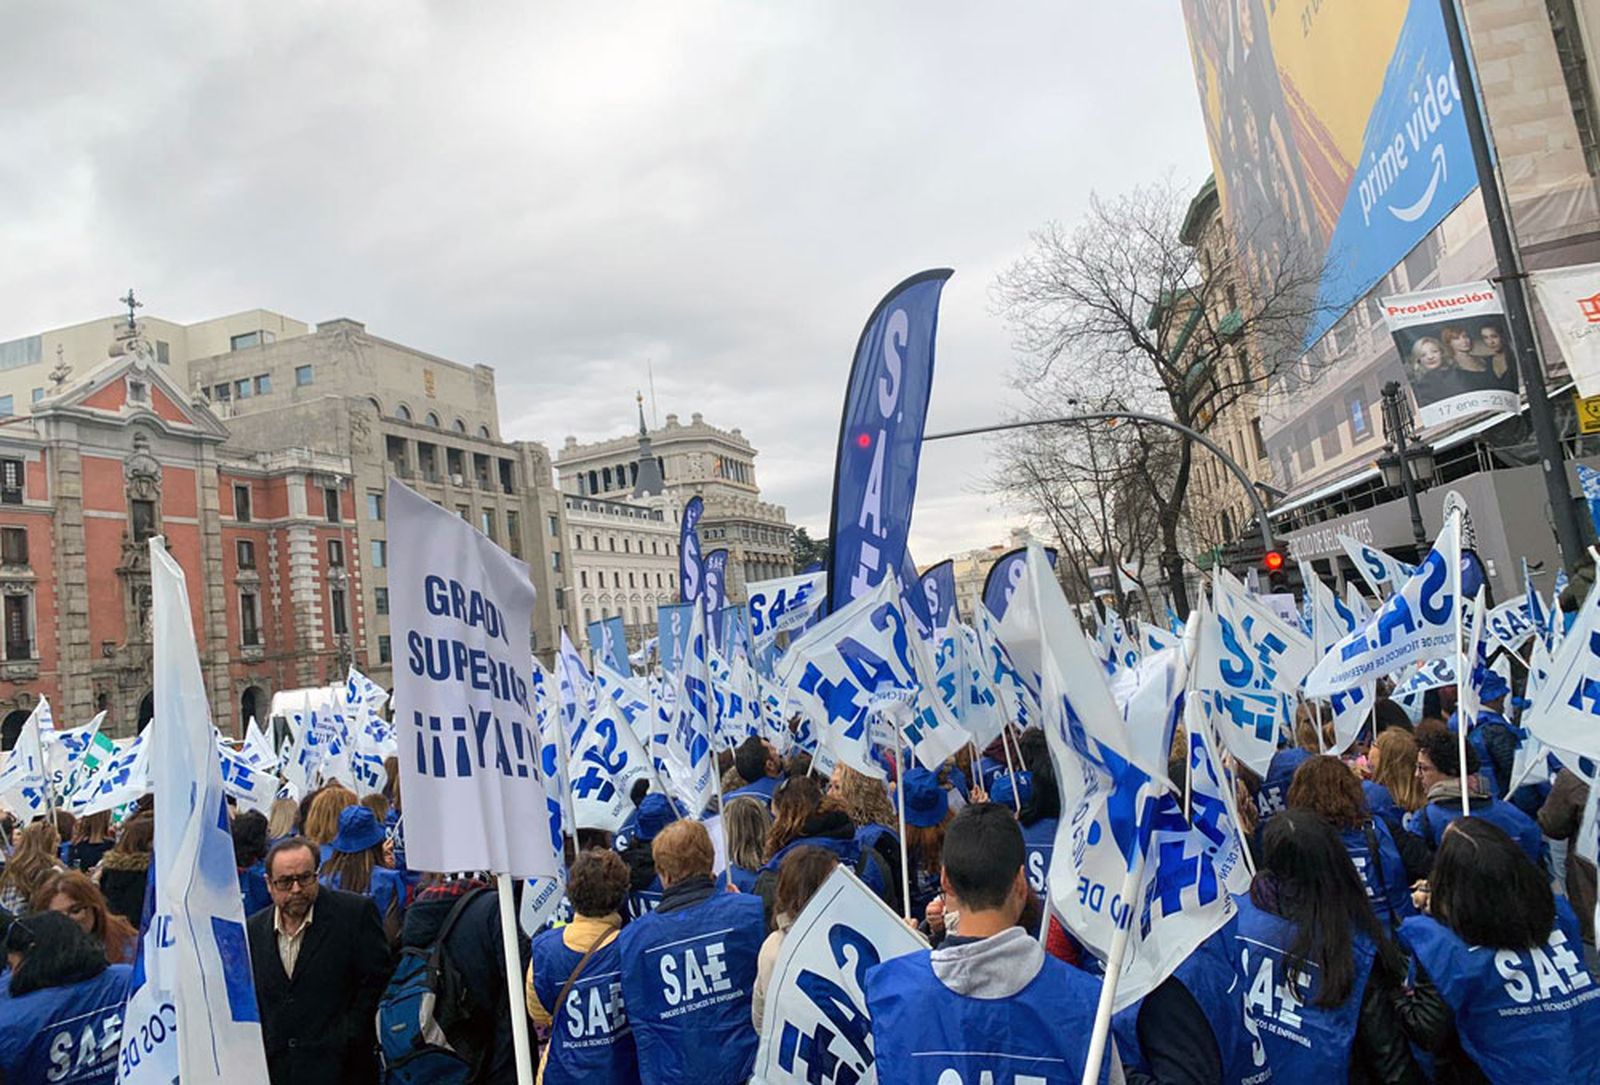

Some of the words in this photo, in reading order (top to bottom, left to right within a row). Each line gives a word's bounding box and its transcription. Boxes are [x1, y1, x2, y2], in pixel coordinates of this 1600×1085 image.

[1358, 132, 1408, 227] prime
[1387, 290, 1494, 316] Prostitución
[661, 942, 732, 1006] S.A.E
